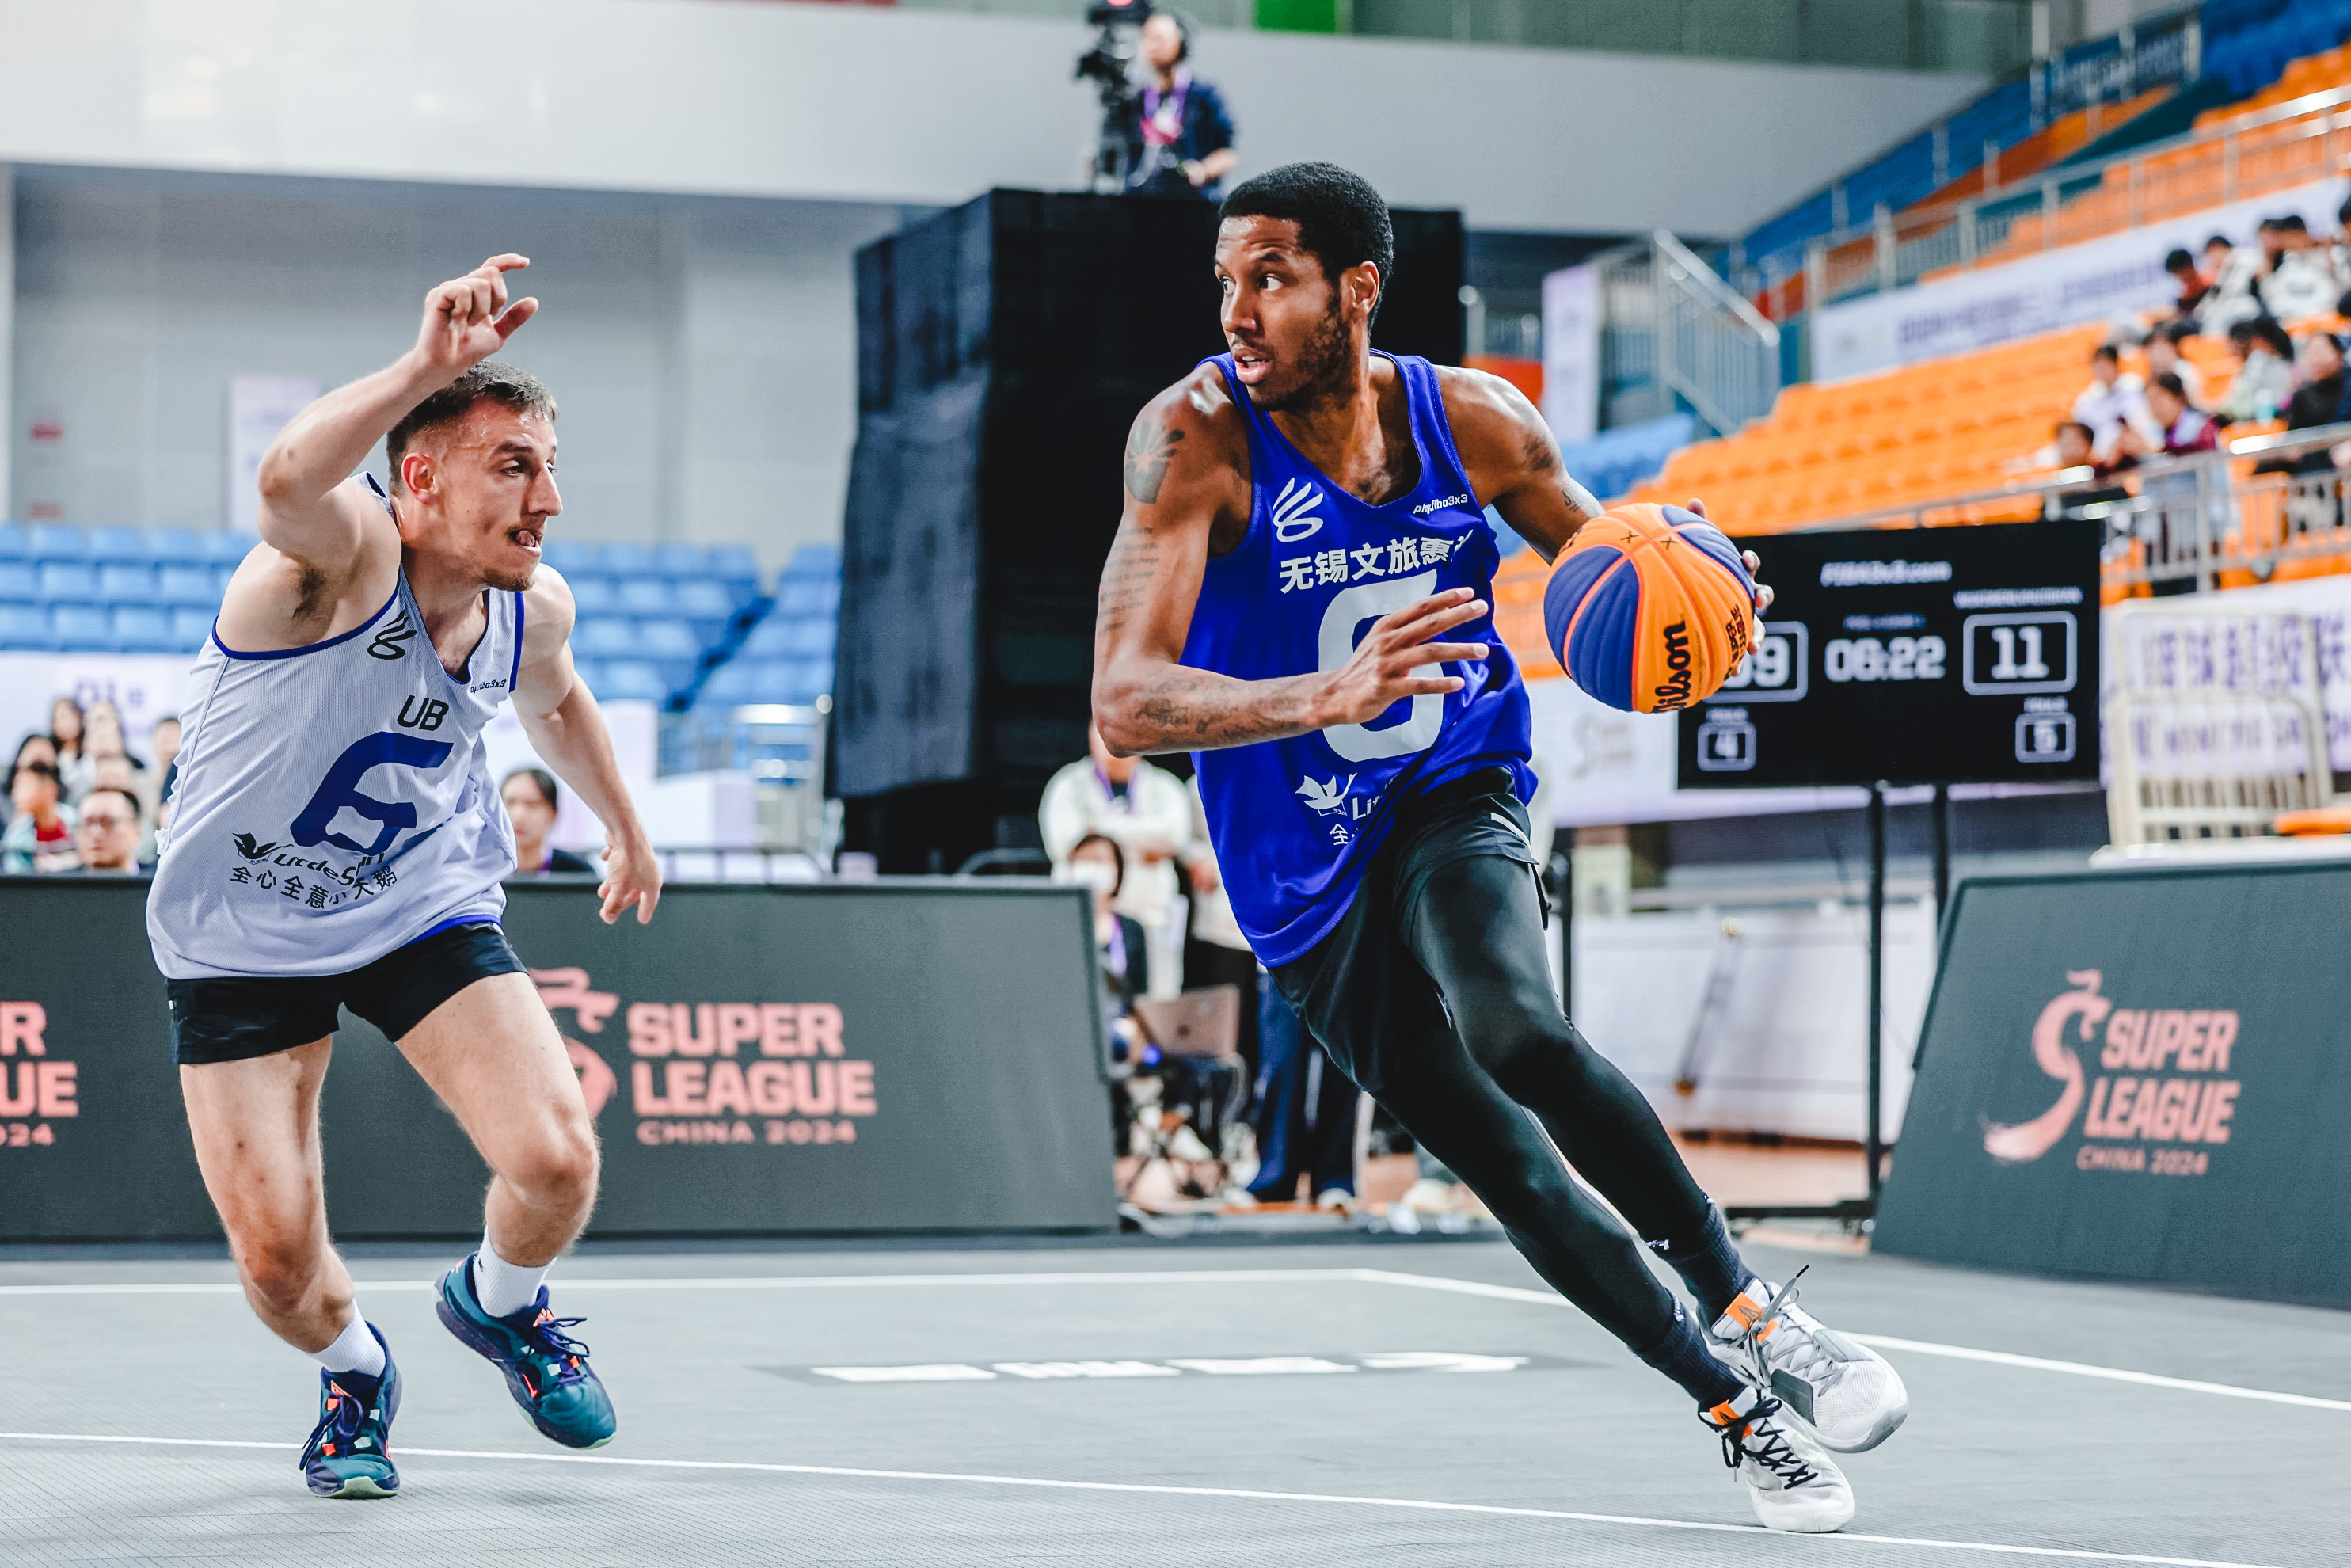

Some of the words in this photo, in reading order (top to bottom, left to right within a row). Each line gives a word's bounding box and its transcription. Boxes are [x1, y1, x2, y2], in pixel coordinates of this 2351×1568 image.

[1413, 493, 1469, 516] play.fiba3x3
[1991, 626, 2051, 680] 11
[397, 695, 449, 732] UB
[290, 730, 455, 856] 6
[626, 1001, 846, 1058] SUPER
[2101, 1008, 2240, 1073] SUPER
[632, 1060, 877, 1117] LEAGUE
[2083, 1075, 2242, 1144] LEAGUE
[636, 1119, 755, 1146] CHINA
[764, 1118, 858, 1145] 2024
[2075, 1144, 2146, 1171] CHINA
[2149, 1148, 2210, 1175] 2024
